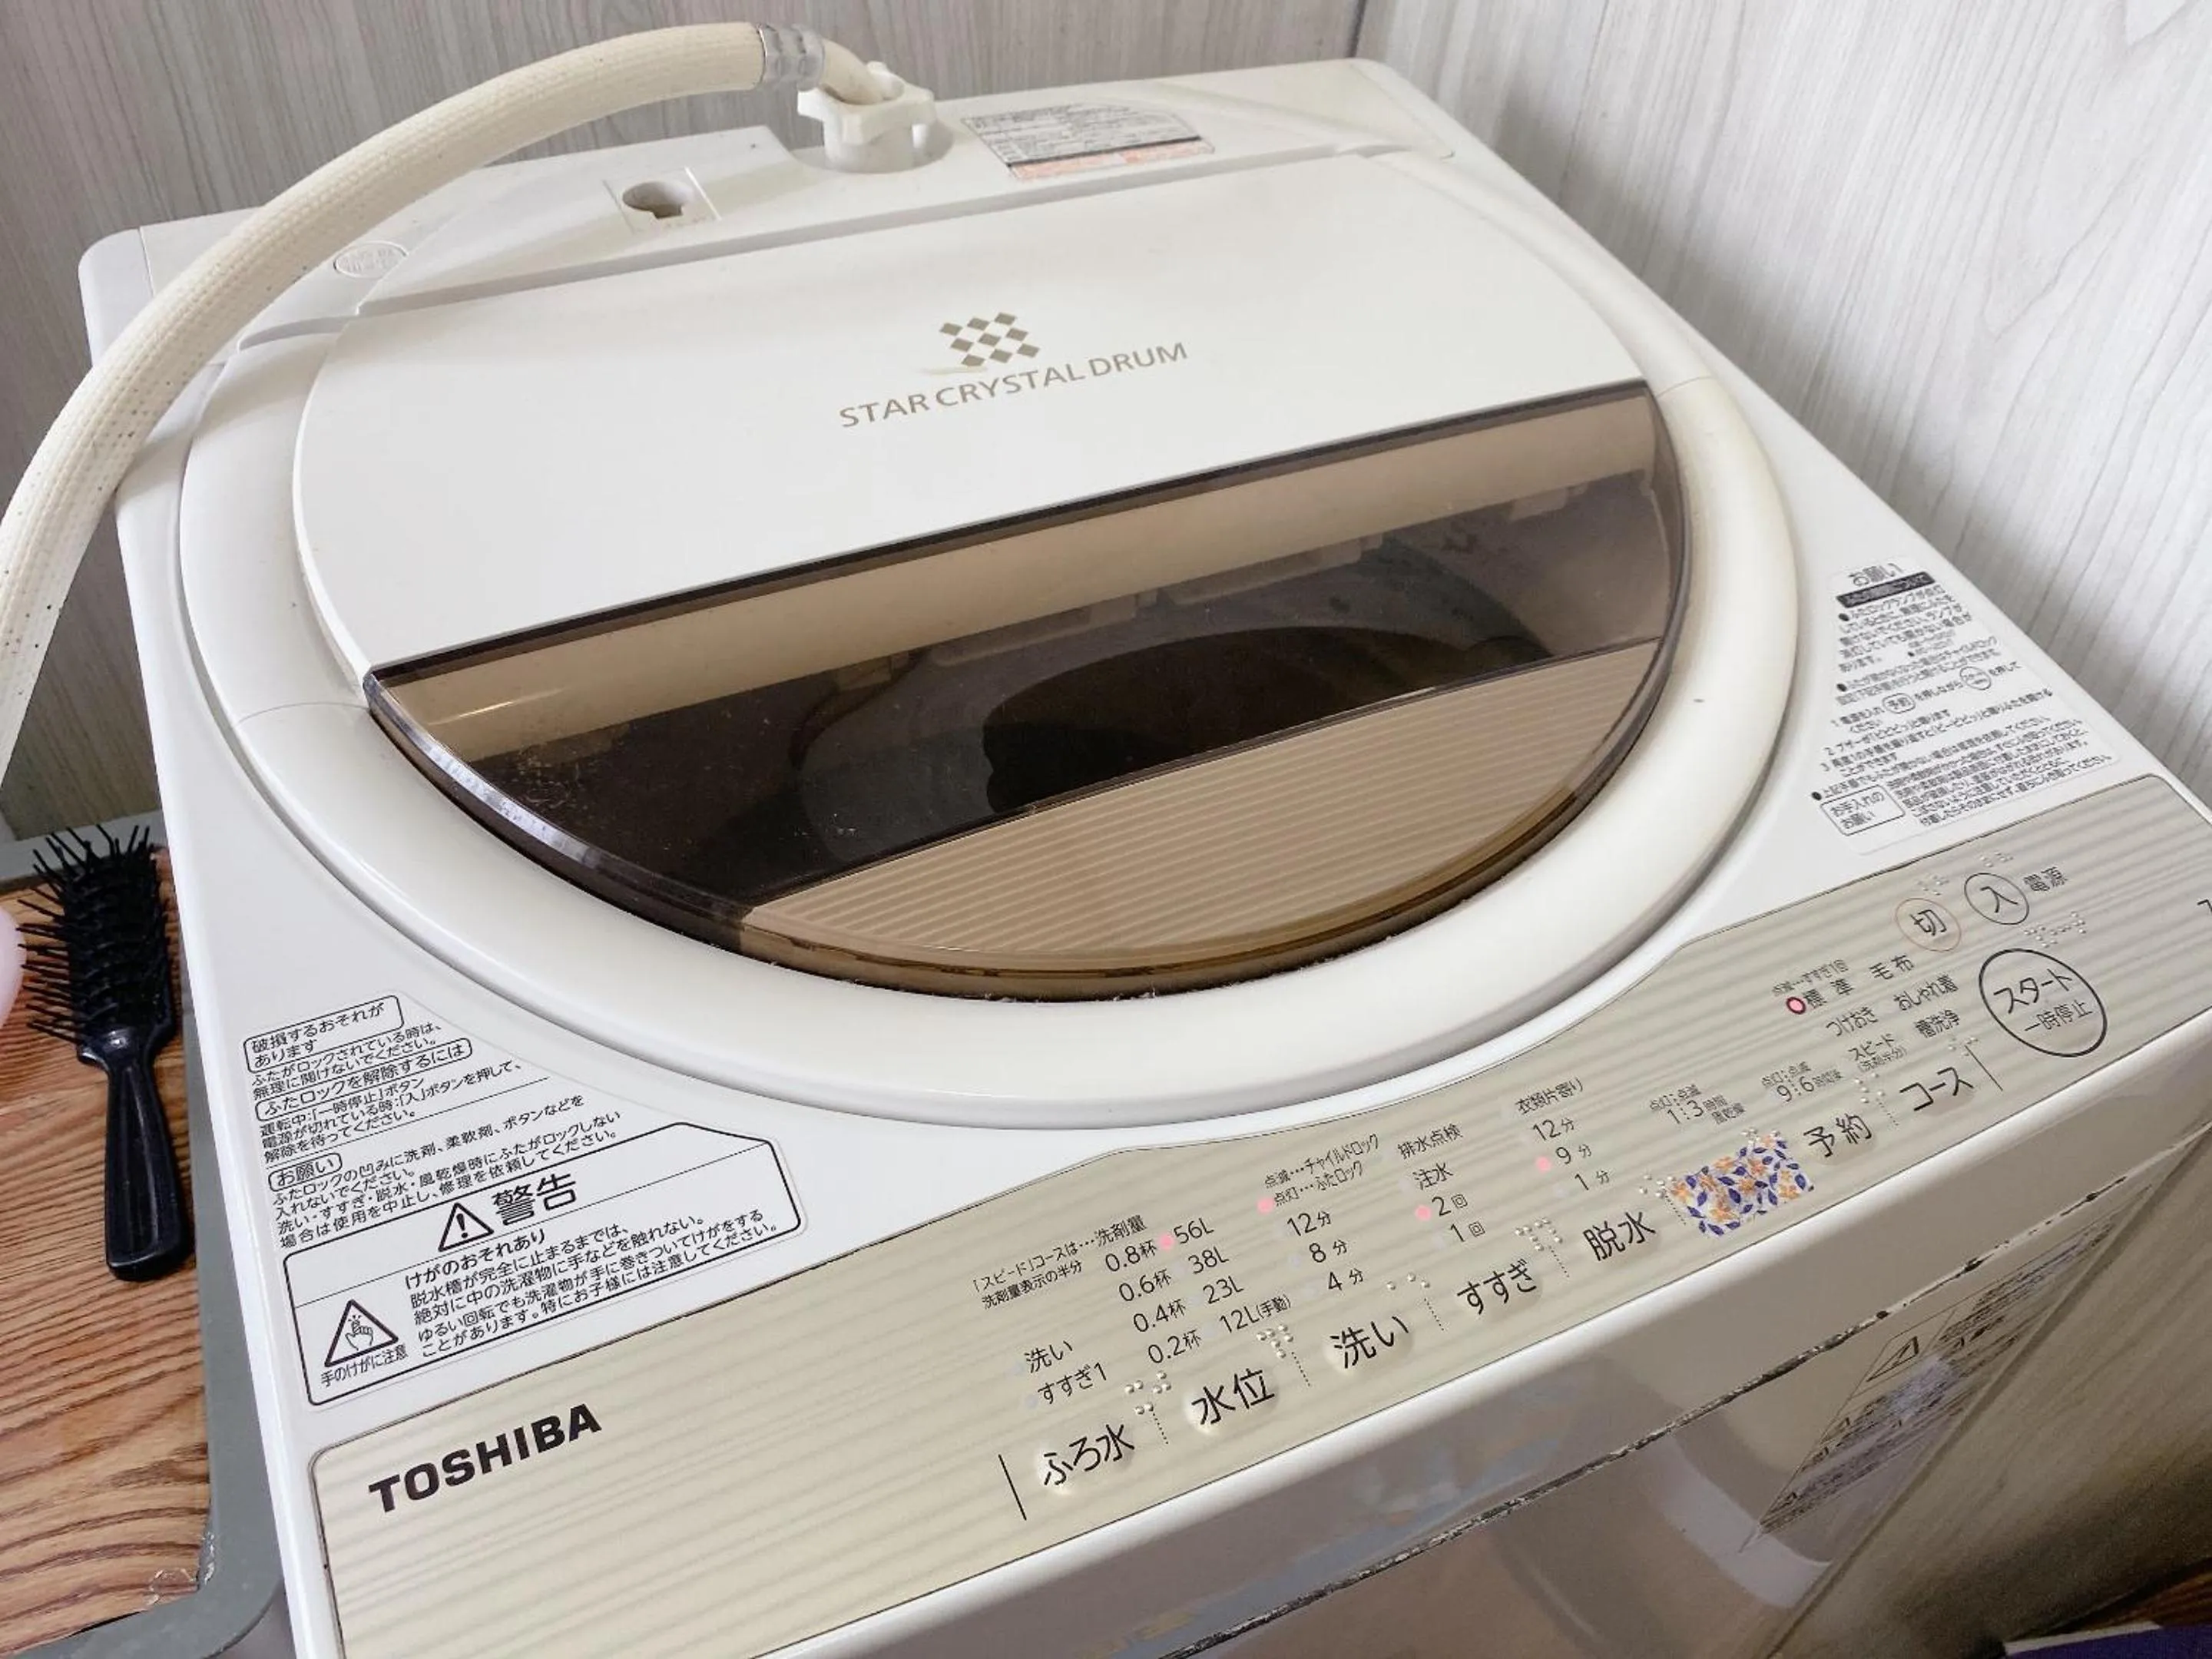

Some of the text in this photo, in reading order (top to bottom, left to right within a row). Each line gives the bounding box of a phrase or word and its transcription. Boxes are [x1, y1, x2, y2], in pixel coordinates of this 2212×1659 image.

[839, 342, 1188, 427] STAR CRYSTAL DRUM
[1979, 886, 2019, 914] 入
[2023, 866, 2069, 893] 電源
[1909, 909, 1949, 937] 切
[1824, 974, 1959, 1038] つけおき おしゃれ着
[1992, 967, 2074, 1015] スタート
[250, 1002, 386, 1054] 破損するおそれが
[1847, 1008, 1962, 1061] スピード 槽洗浄
[2024, 998, 2095, 1033] 一時停止
[254, 1039, 318, 1068] あります
[264, 1044, 465, 1115] ふたロックを解除するには
[1515, 1078, 1584, 1116] 衣類片寄り
[1899, 1066, 1975, 1111] コース
[263, 1109, 416, 1164] 解除を待ってください。
[1397, 1123, 1464, 1161] 排水点検
[1804, 1113, 1873, 1160] 予約
[276, 1157, 335, 1186] お願い
[1412, 1161, 1455, 1191] 注水
[275, 1170, 416, 1220] 入れないでください。
[491, 1172, 578, 1227] 警告
[1173, 1217, 1215, 1245] 56L
[405, 1228, 546, 1290] けがのおそれあり
[410, 1224, 628, 1308] 脱水槽が完全に止まるまでは、
[1187, 1245, 1230, 1275] 38L
[982, 1260, 1084, 1310] 洗剤量表示の半分
[1203, 1275, 1245, 1305] 23L
[320, 1345, 409, 1388] 手のけがに注意
[1025, 1339, 1074, 1374] 洗い
[1042, 1210, 1657, 1487] ふろ水 水位 洗い すすぎ 脱水
[1038, 1362, 1108, 1406] すすぎ1
[369, 1402, 603, 1513] TOSHIBA
